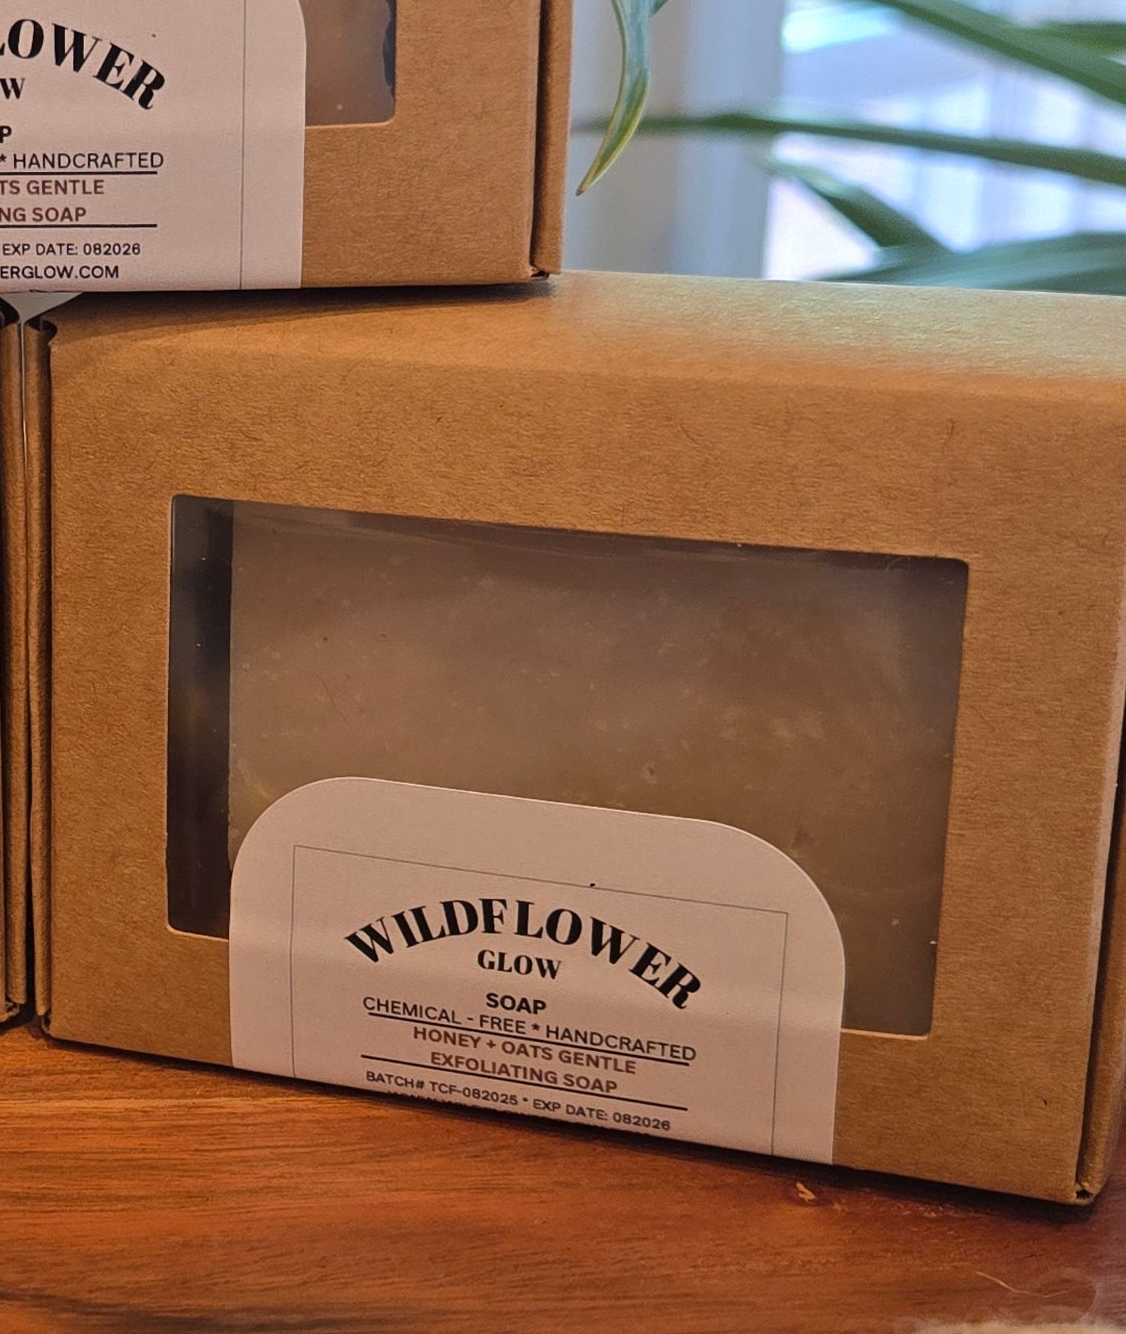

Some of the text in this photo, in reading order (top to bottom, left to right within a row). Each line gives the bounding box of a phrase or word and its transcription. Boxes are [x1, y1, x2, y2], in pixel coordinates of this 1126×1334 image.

[13, 152, 164, 169] HANDCRAFTED
[26, 179, 105, 195] GENTLE
[31, 207, 87, 222] SOAP
[2, 243, 31, 256] EXP
[36, 243, 78, 256] DATE:
[83, 243, 141, 256] 082026
[344, 898, 703, 1009] WILDFLOWER
[477, 950, 563, 980] GLOW
[486, 993, 546, 1015] SOAP
[363, 996, 461, 1025] CHEMICAL
[479, 1015, 526, 1034] FREE
[546, 1025, 696, 1061] HANDCRAFTED
[413, 1027, 637, 1075] HONEY + OATS GENTLE
[430, 1051, 618, 1094] EXFOLIATING SOAP
[366, 1071, 424, 1089] BATCH#
[429, 1081, 518, 1106] TCF-082025
[532, 1098, 561, 1113] EXP
[565, 1104, 608, 1121] DATE:
[613, 1111, 671, 1131] 082026
